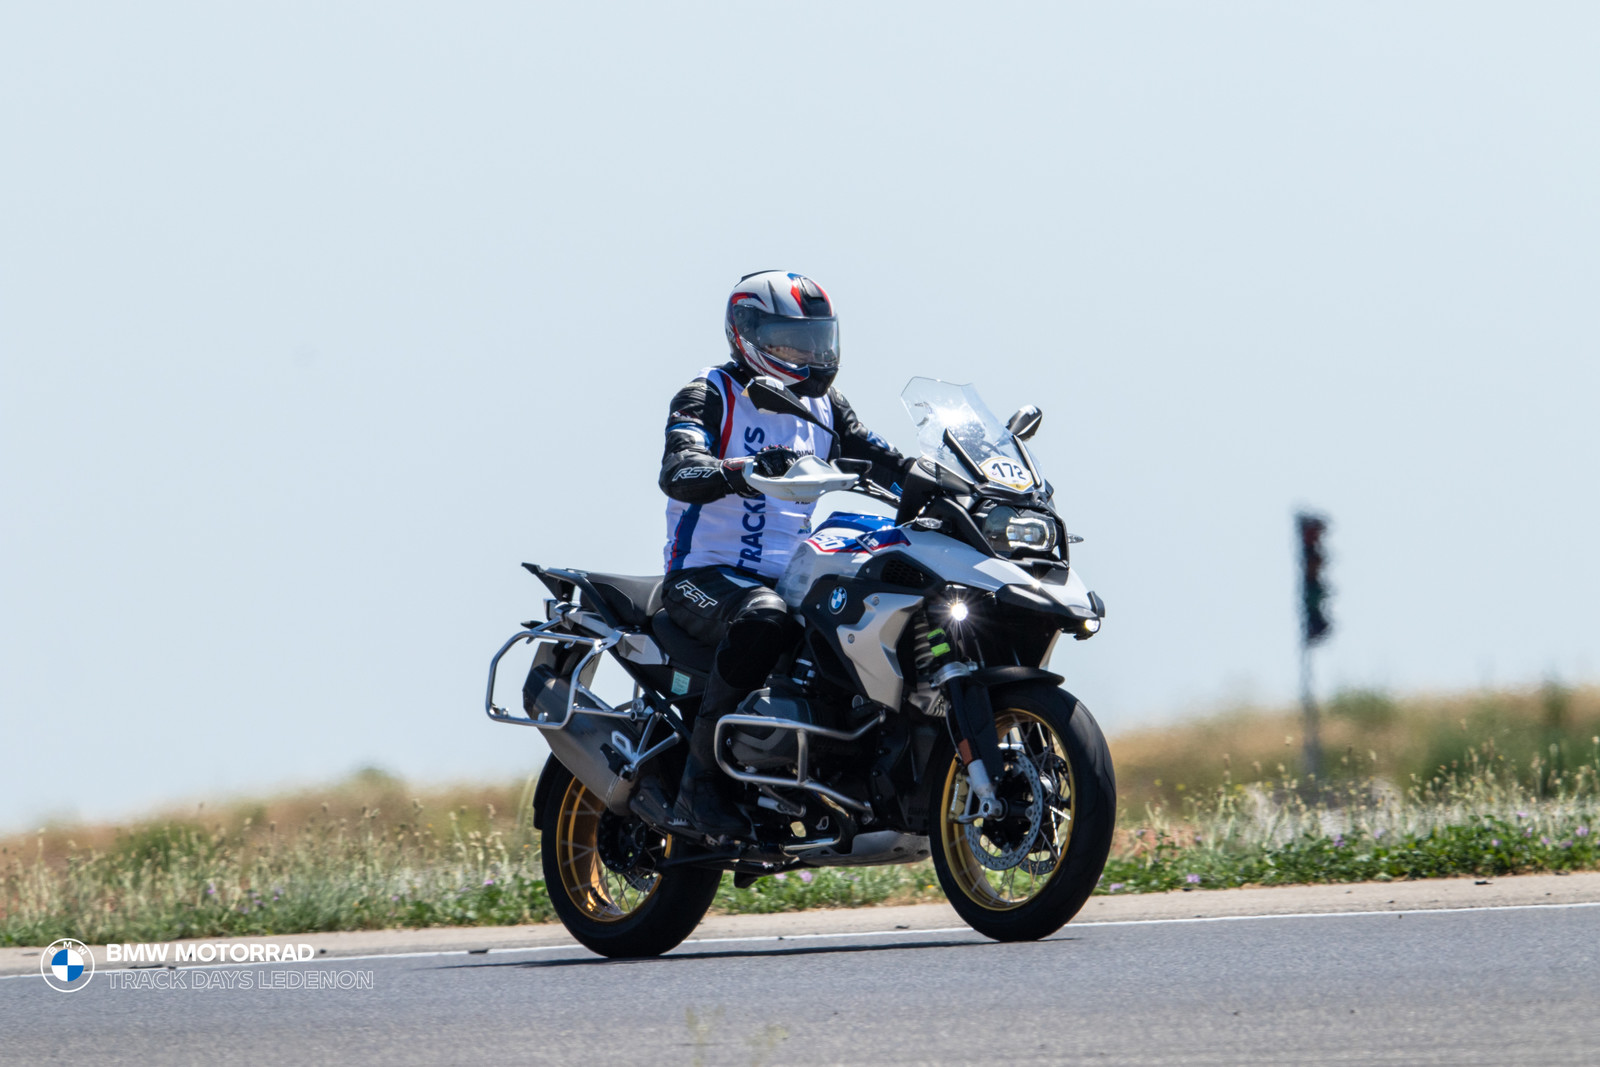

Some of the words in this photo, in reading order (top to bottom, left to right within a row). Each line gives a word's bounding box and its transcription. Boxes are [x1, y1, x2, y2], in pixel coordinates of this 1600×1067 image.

[672, 466, 718, 482] RST
[992, 463, 1027, 480] 172
[737, 426, 766, 573] TRACKYS
[675, 580, 718, 608] RST
